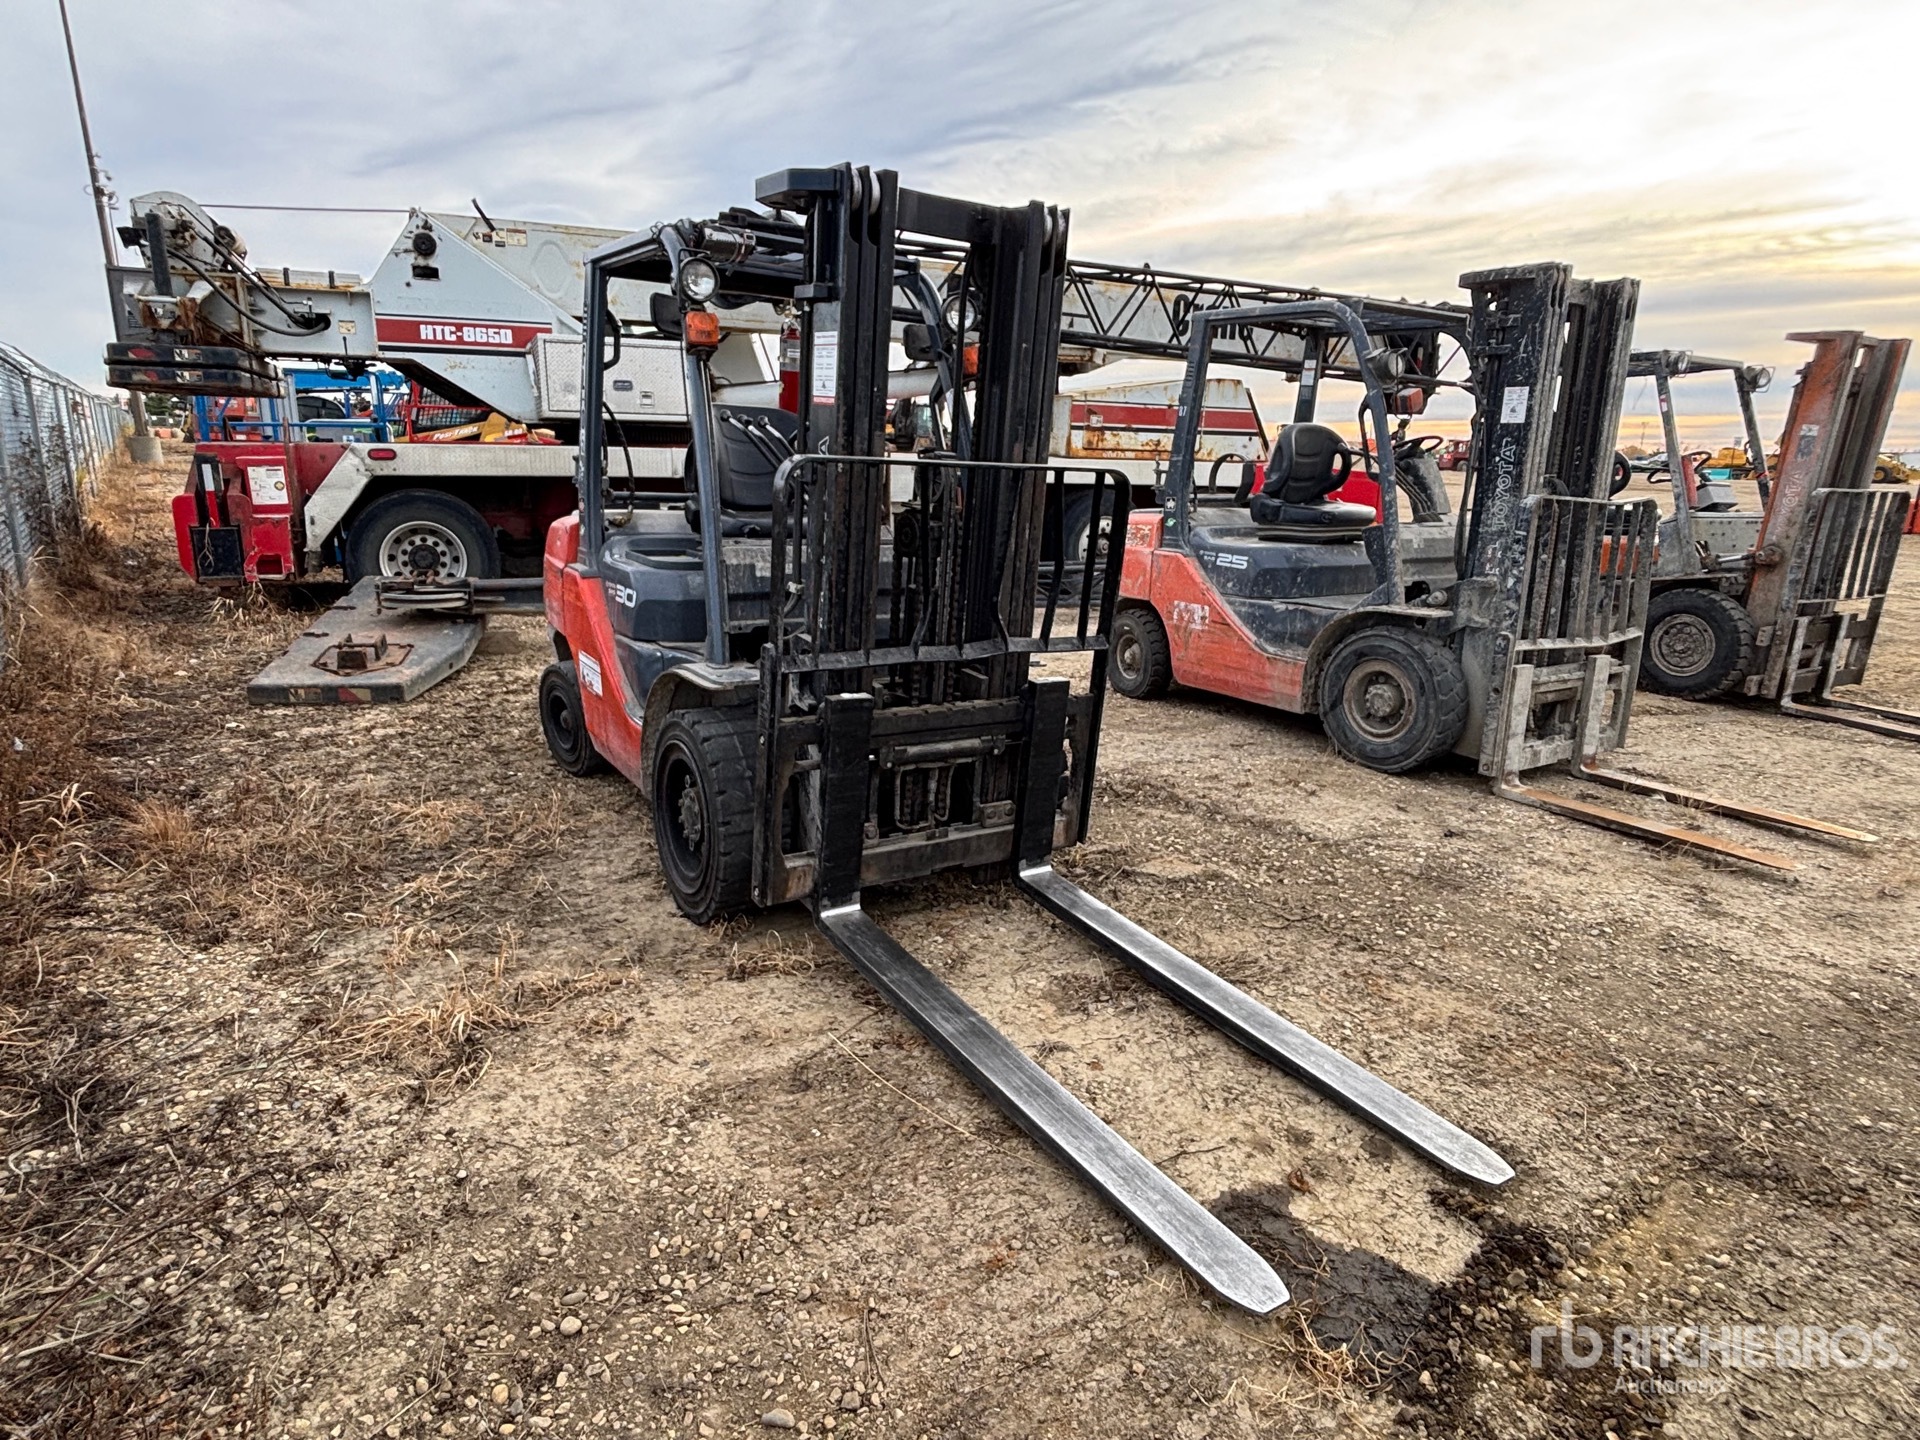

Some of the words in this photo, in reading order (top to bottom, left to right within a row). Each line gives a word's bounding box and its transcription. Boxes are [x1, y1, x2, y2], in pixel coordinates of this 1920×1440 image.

[419, 324, 513, 344] HTC-8650
[1492, 444, 1516, 532] TOYOTA
[1216, 552, 1249, 570] 25
[615, 584, 637, 608] 30
